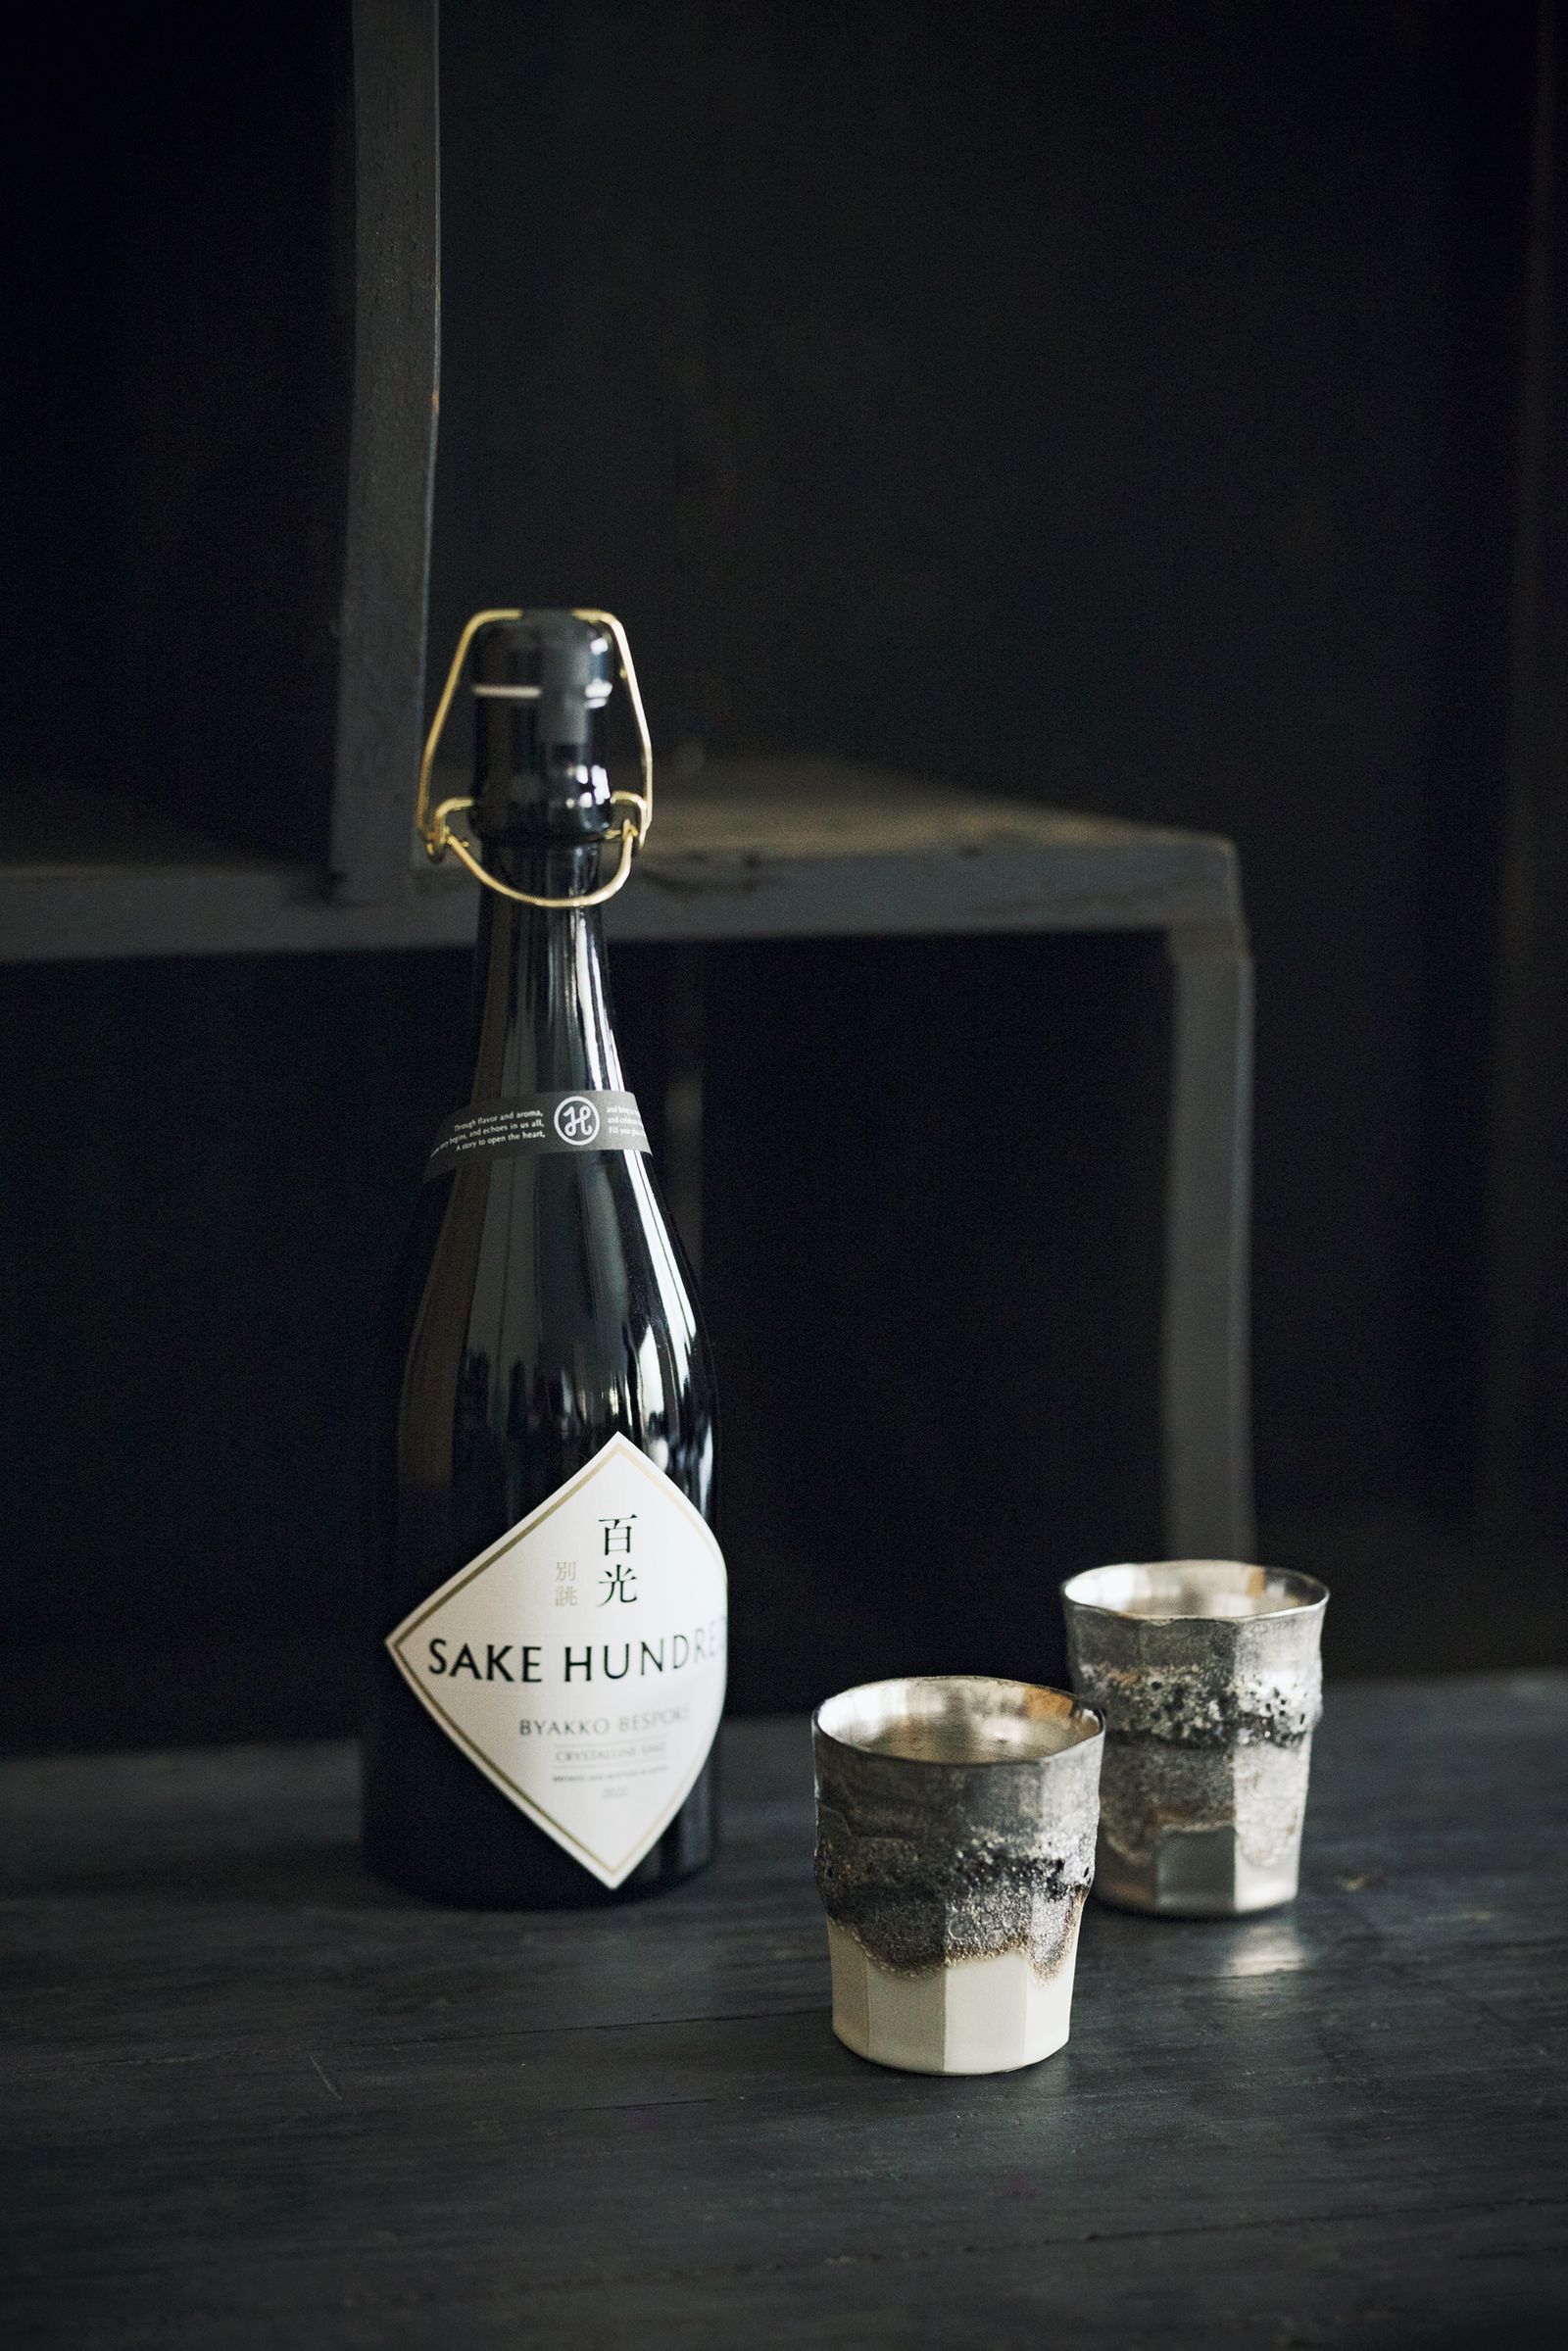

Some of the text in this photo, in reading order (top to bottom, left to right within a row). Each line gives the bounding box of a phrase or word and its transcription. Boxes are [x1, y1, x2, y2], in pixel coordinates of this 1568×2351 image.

[500, 1111, 514, 1121] and
[469, 1128, 482, 1138] and
[482, 1125, 508, 1135] echoes
[487, 1135, 507, 1146] open
[508, 1132, 520, 1141] the
[598, 1514, 638, 1607] 百光
[427, 1615, 725, 1684] SAKE HUNDRE
[519, 1718, 611, 1736] BYAKKO
